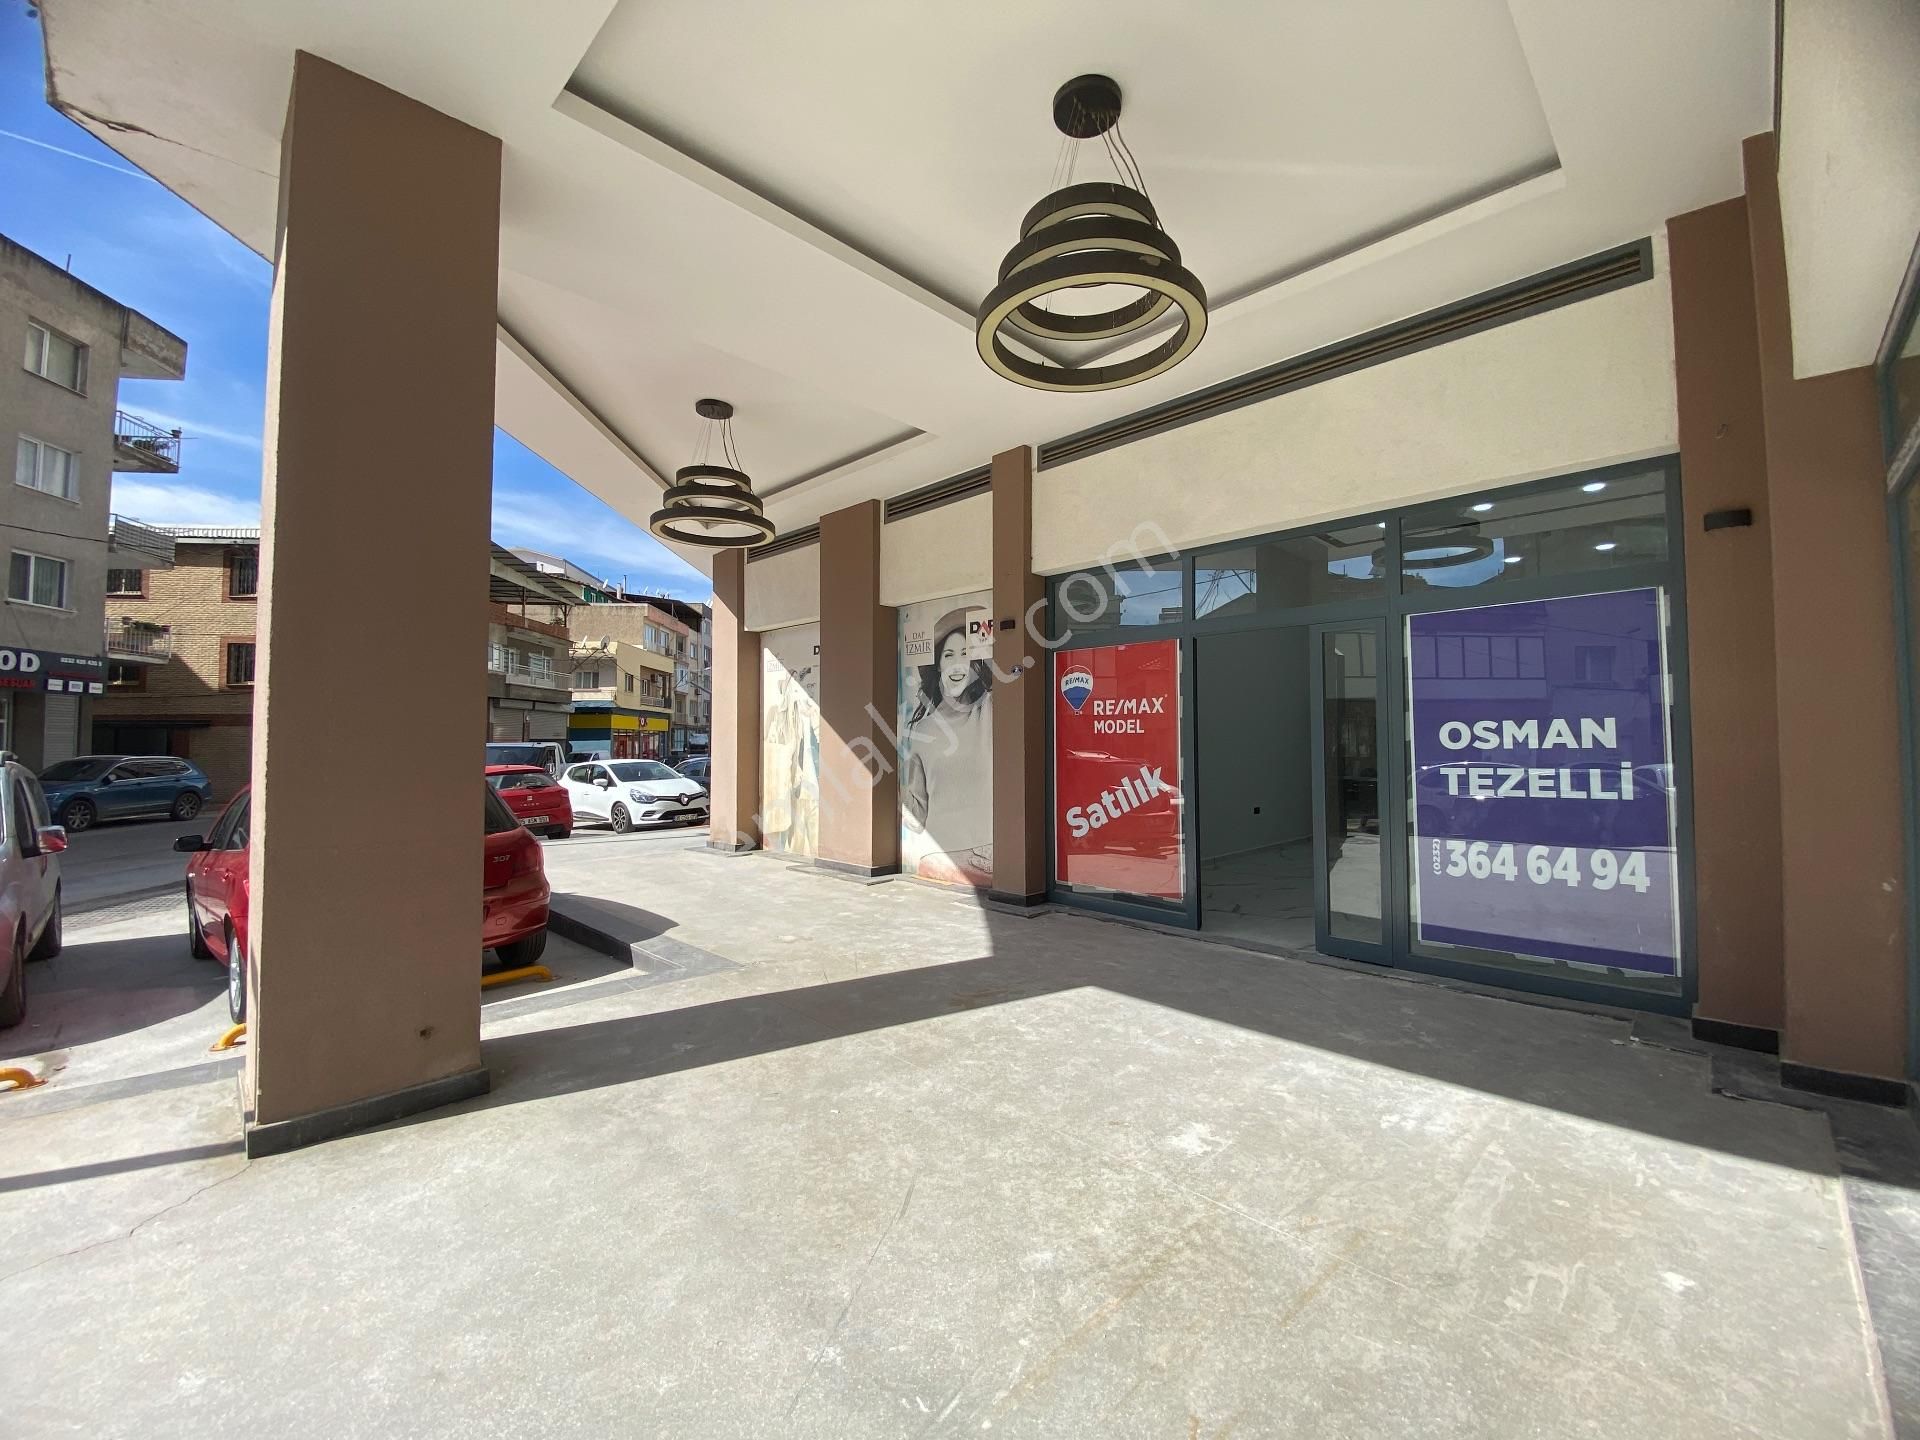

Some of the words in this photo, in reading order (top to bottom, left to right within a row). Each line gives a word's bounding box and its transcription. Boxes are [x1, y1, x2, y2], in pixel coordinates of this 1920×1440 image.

[1065, 676, 1090, 686] RE/MAX
[1093, 696, 1164, 715] RE/MAX
[1094, 719, 1145, 734] MODEL
[1438, 717, 1617, 750] OSMAN
[1439, 761, 1634, 800] TEZELLİ
[1066, 765, 1171, 838] Satılık
[492, 854, 511, 863] 307
[1433, 839, 1441, 875] (0232)
[1445, 840, 1518, 881] 364
[1526, 845, 1581, 887] 64
[1590, 848, 1651, 893] 94
